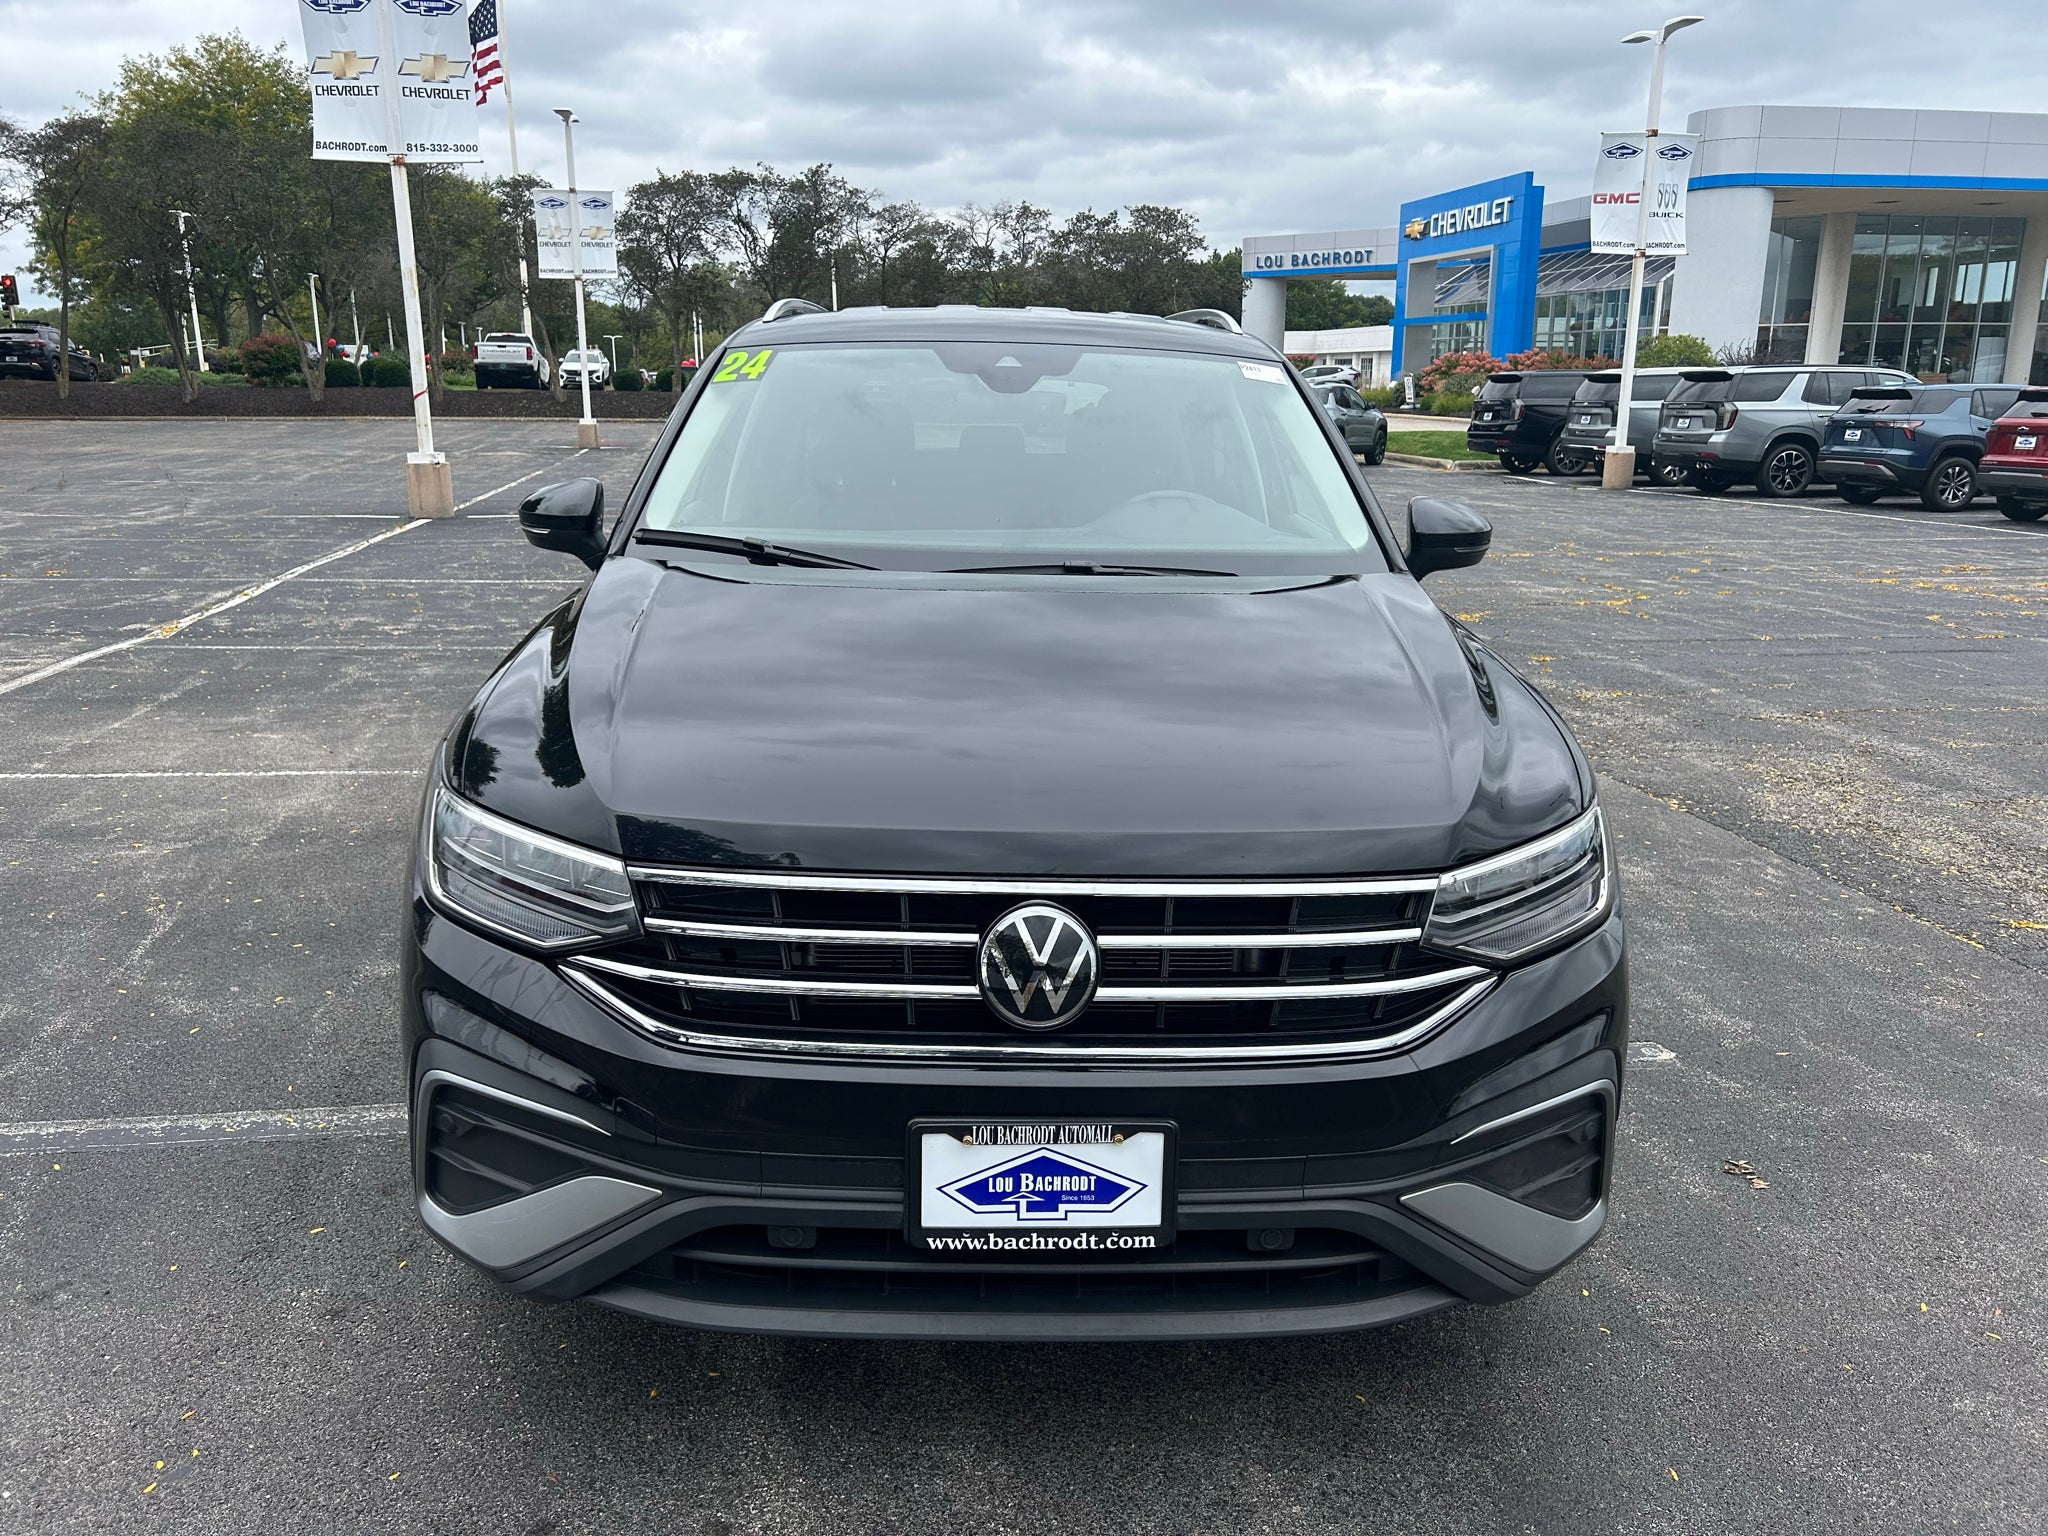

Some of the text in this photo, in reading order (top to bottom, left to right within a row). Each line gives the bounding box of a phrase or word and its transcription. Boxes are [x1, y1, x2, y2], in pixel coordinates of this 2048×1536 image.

[315, 85, 380, 97] CHEVROLET
[402, 86, 471, 100] CHEVROLET
[315, 141, 387, 153] BACHRODT.com
[406, 143, 478, 153] 815-332-3000
[1592, 192, 1641, 204] GMC
[1430, 196, 1514, 238] CHEVROLET
[1648, 211, 1684, 219] BUICK
[1256, 249, 1374, 269] LOU BACHRODT
[713, 349, 773, 382] 24
[972, 1125, 1113, 1145] LOU BACHRODT AUTOMALL
[988, 1177, 1013, 1193] LOU
[926, 1232, 1156, 1250] www.bachrodt.com
